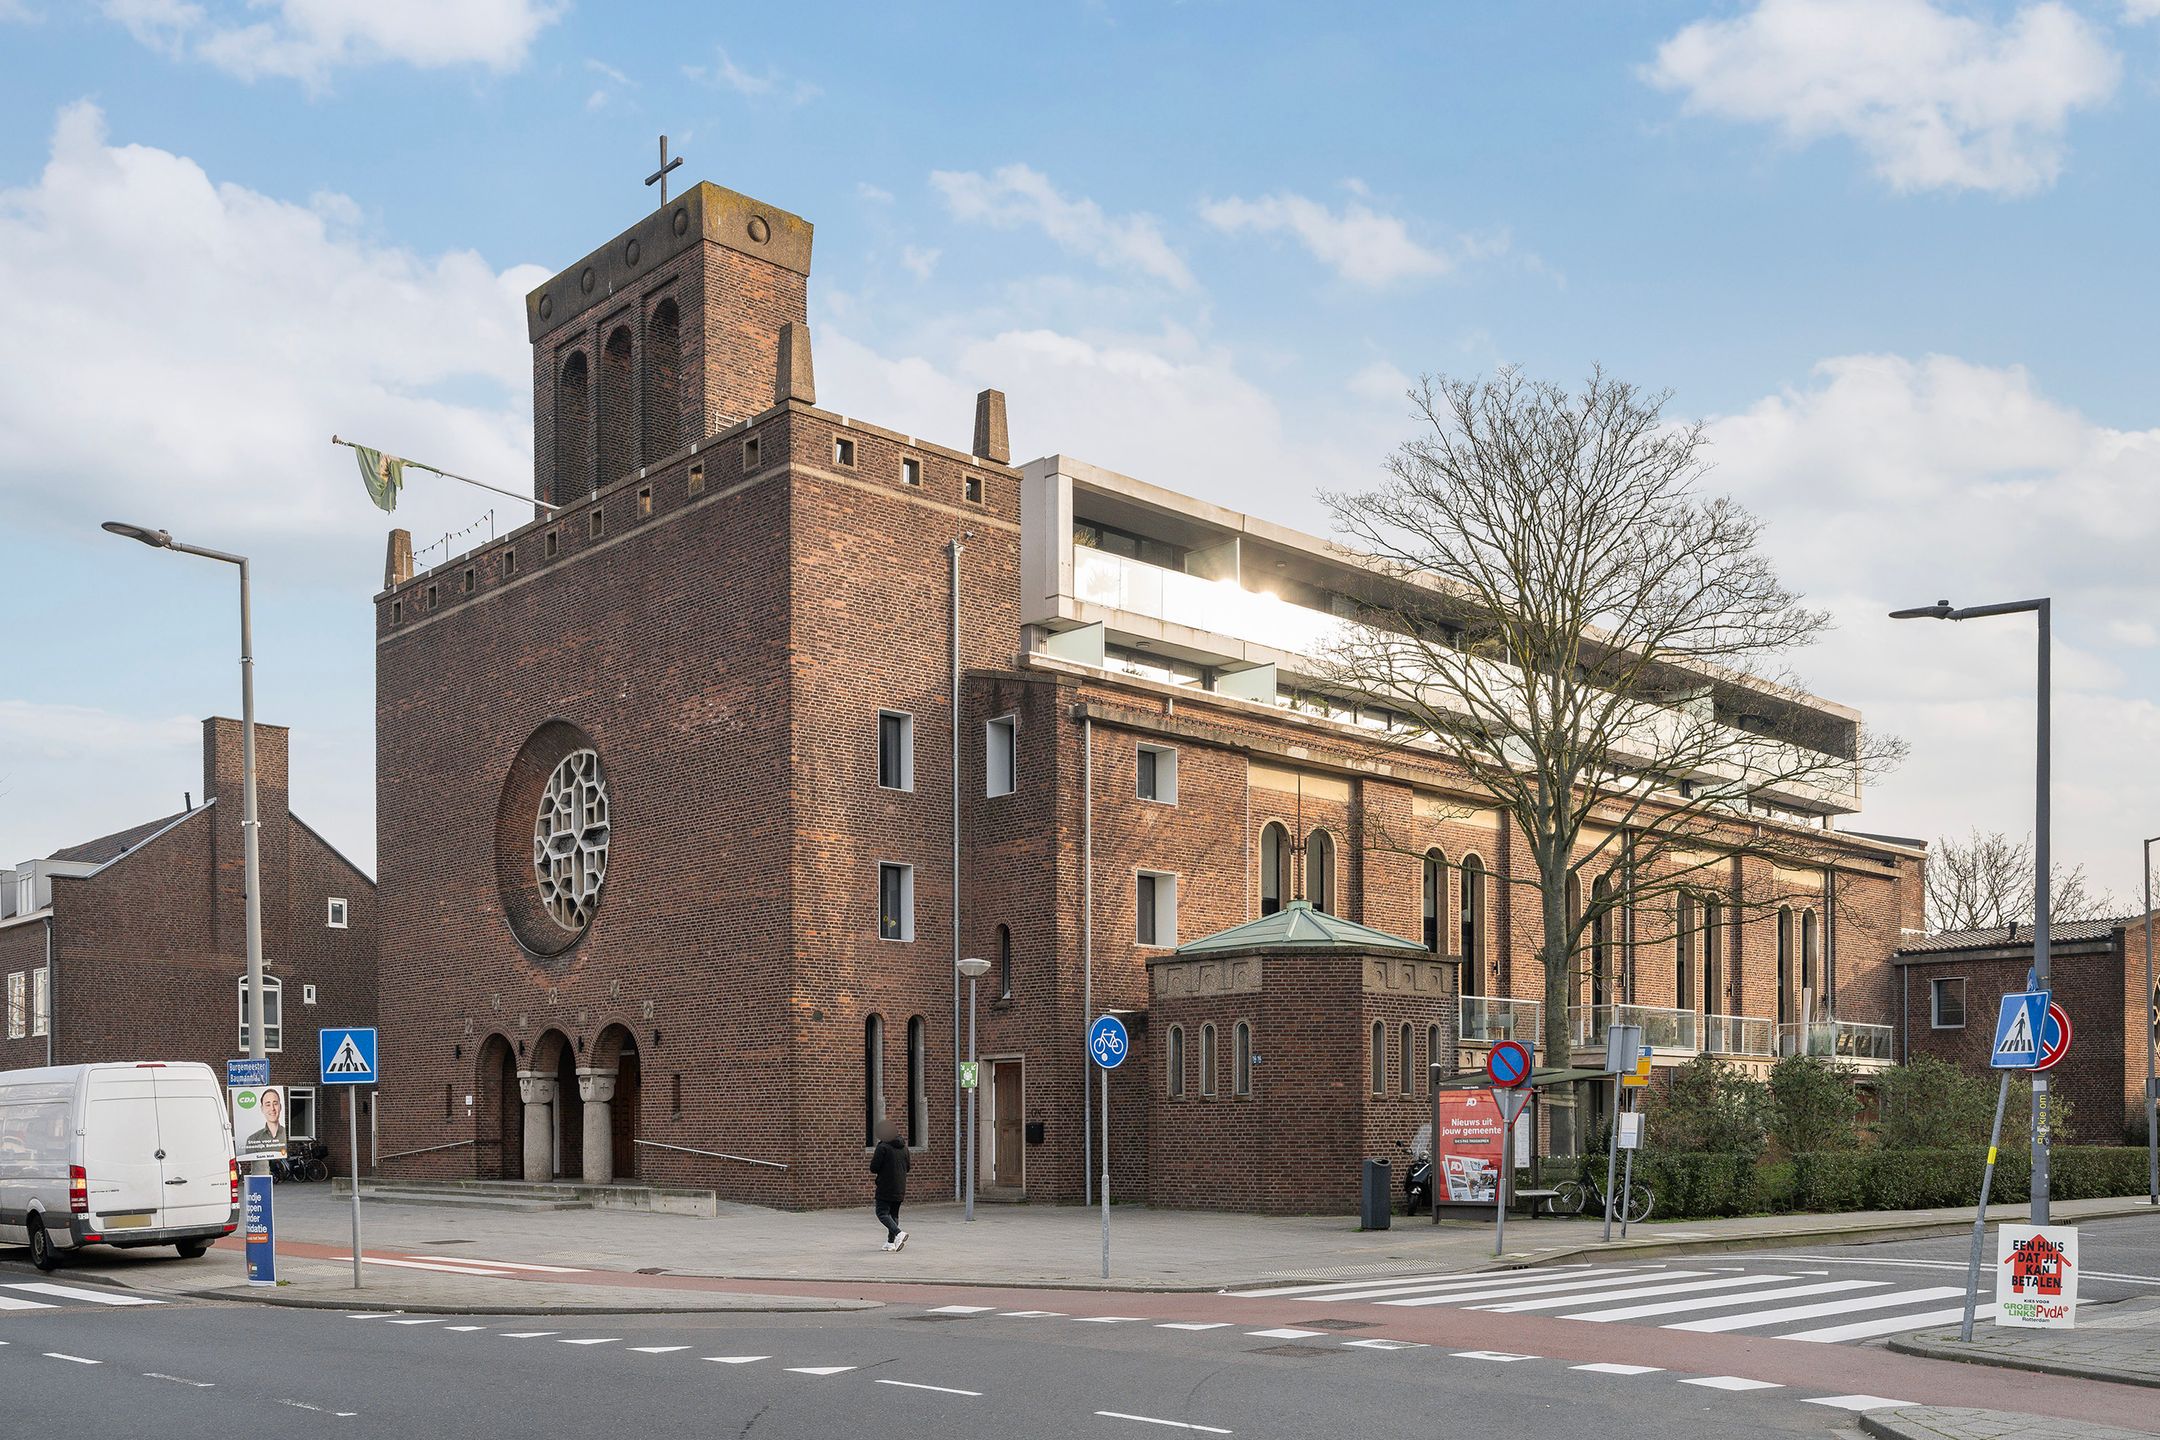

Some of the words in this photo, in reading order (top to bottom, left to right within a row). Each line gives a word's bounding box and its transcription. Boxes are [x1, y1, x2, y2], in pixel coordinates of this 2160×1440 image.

[229, 1063, 265, 1073] Burgemeester
[1466, 1098, 1477, 1106] AD
[2040, 1095, 2046, 1109] om
[1451, 1118, 1480, 1126] Nieuws
[1482, 1117, 1493, 1126] uit
[1442, 1127, 1461, 1136] jouw
[1463, 1127, 1502, 1136] gemeente
[1450, 1160, 1463, 1172] AD
[2013, 1240, 2034, 1251] EEN
[2038, 1241, 2064, 1252] HUIS
[2018, 1253, 2040, 1263] DAT
[2044, 1254, 2059, 1264] JIJ
[2026, 1265, 2050, 1275] KAN
[2012, 1276, 2063, 1288] BETALEN.
[2004, 1303, 2036, 1311] GROEN
[2036, 1305, 2064, 1318] PvdA
